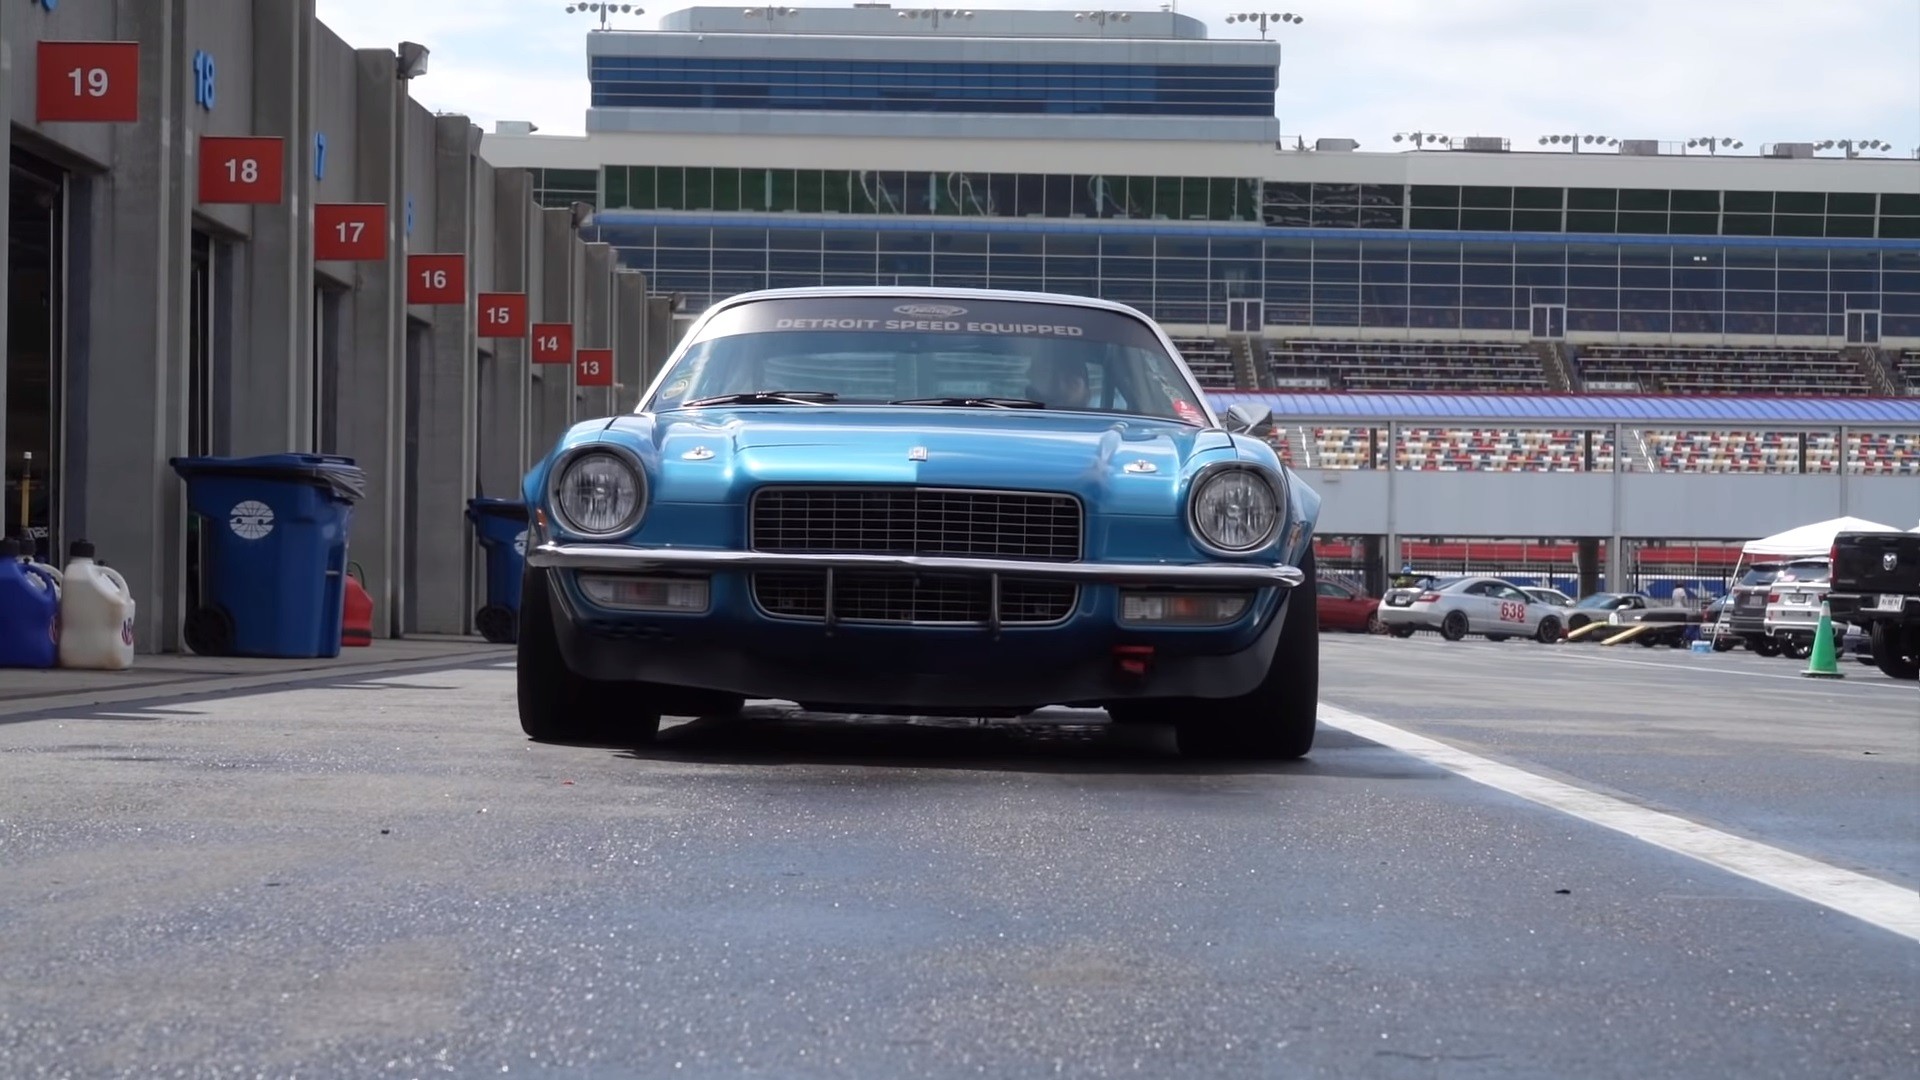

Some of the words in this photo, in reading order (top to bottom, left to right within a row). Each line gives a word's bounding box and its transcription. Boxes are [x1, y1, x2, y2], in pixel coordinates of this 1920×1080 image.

[68, 67, 109, 97] 19
[192, 49, 216, 111] 18
[224, 158, 258, 183] 18
[335, 222, 365, 243] 17
[421, 270, 447, 289] 16
[487, 307, 509, 324] 15
[776, 318, 879, 329] DETROIT
[885, 319, 960, 331] SPEED
[967, 322, 1083, 336] EQUIPPED
[538, 336, 558, 351] 14
[580, 361, 600, 375] 13
[1501, 601, 1525, 619] 638
